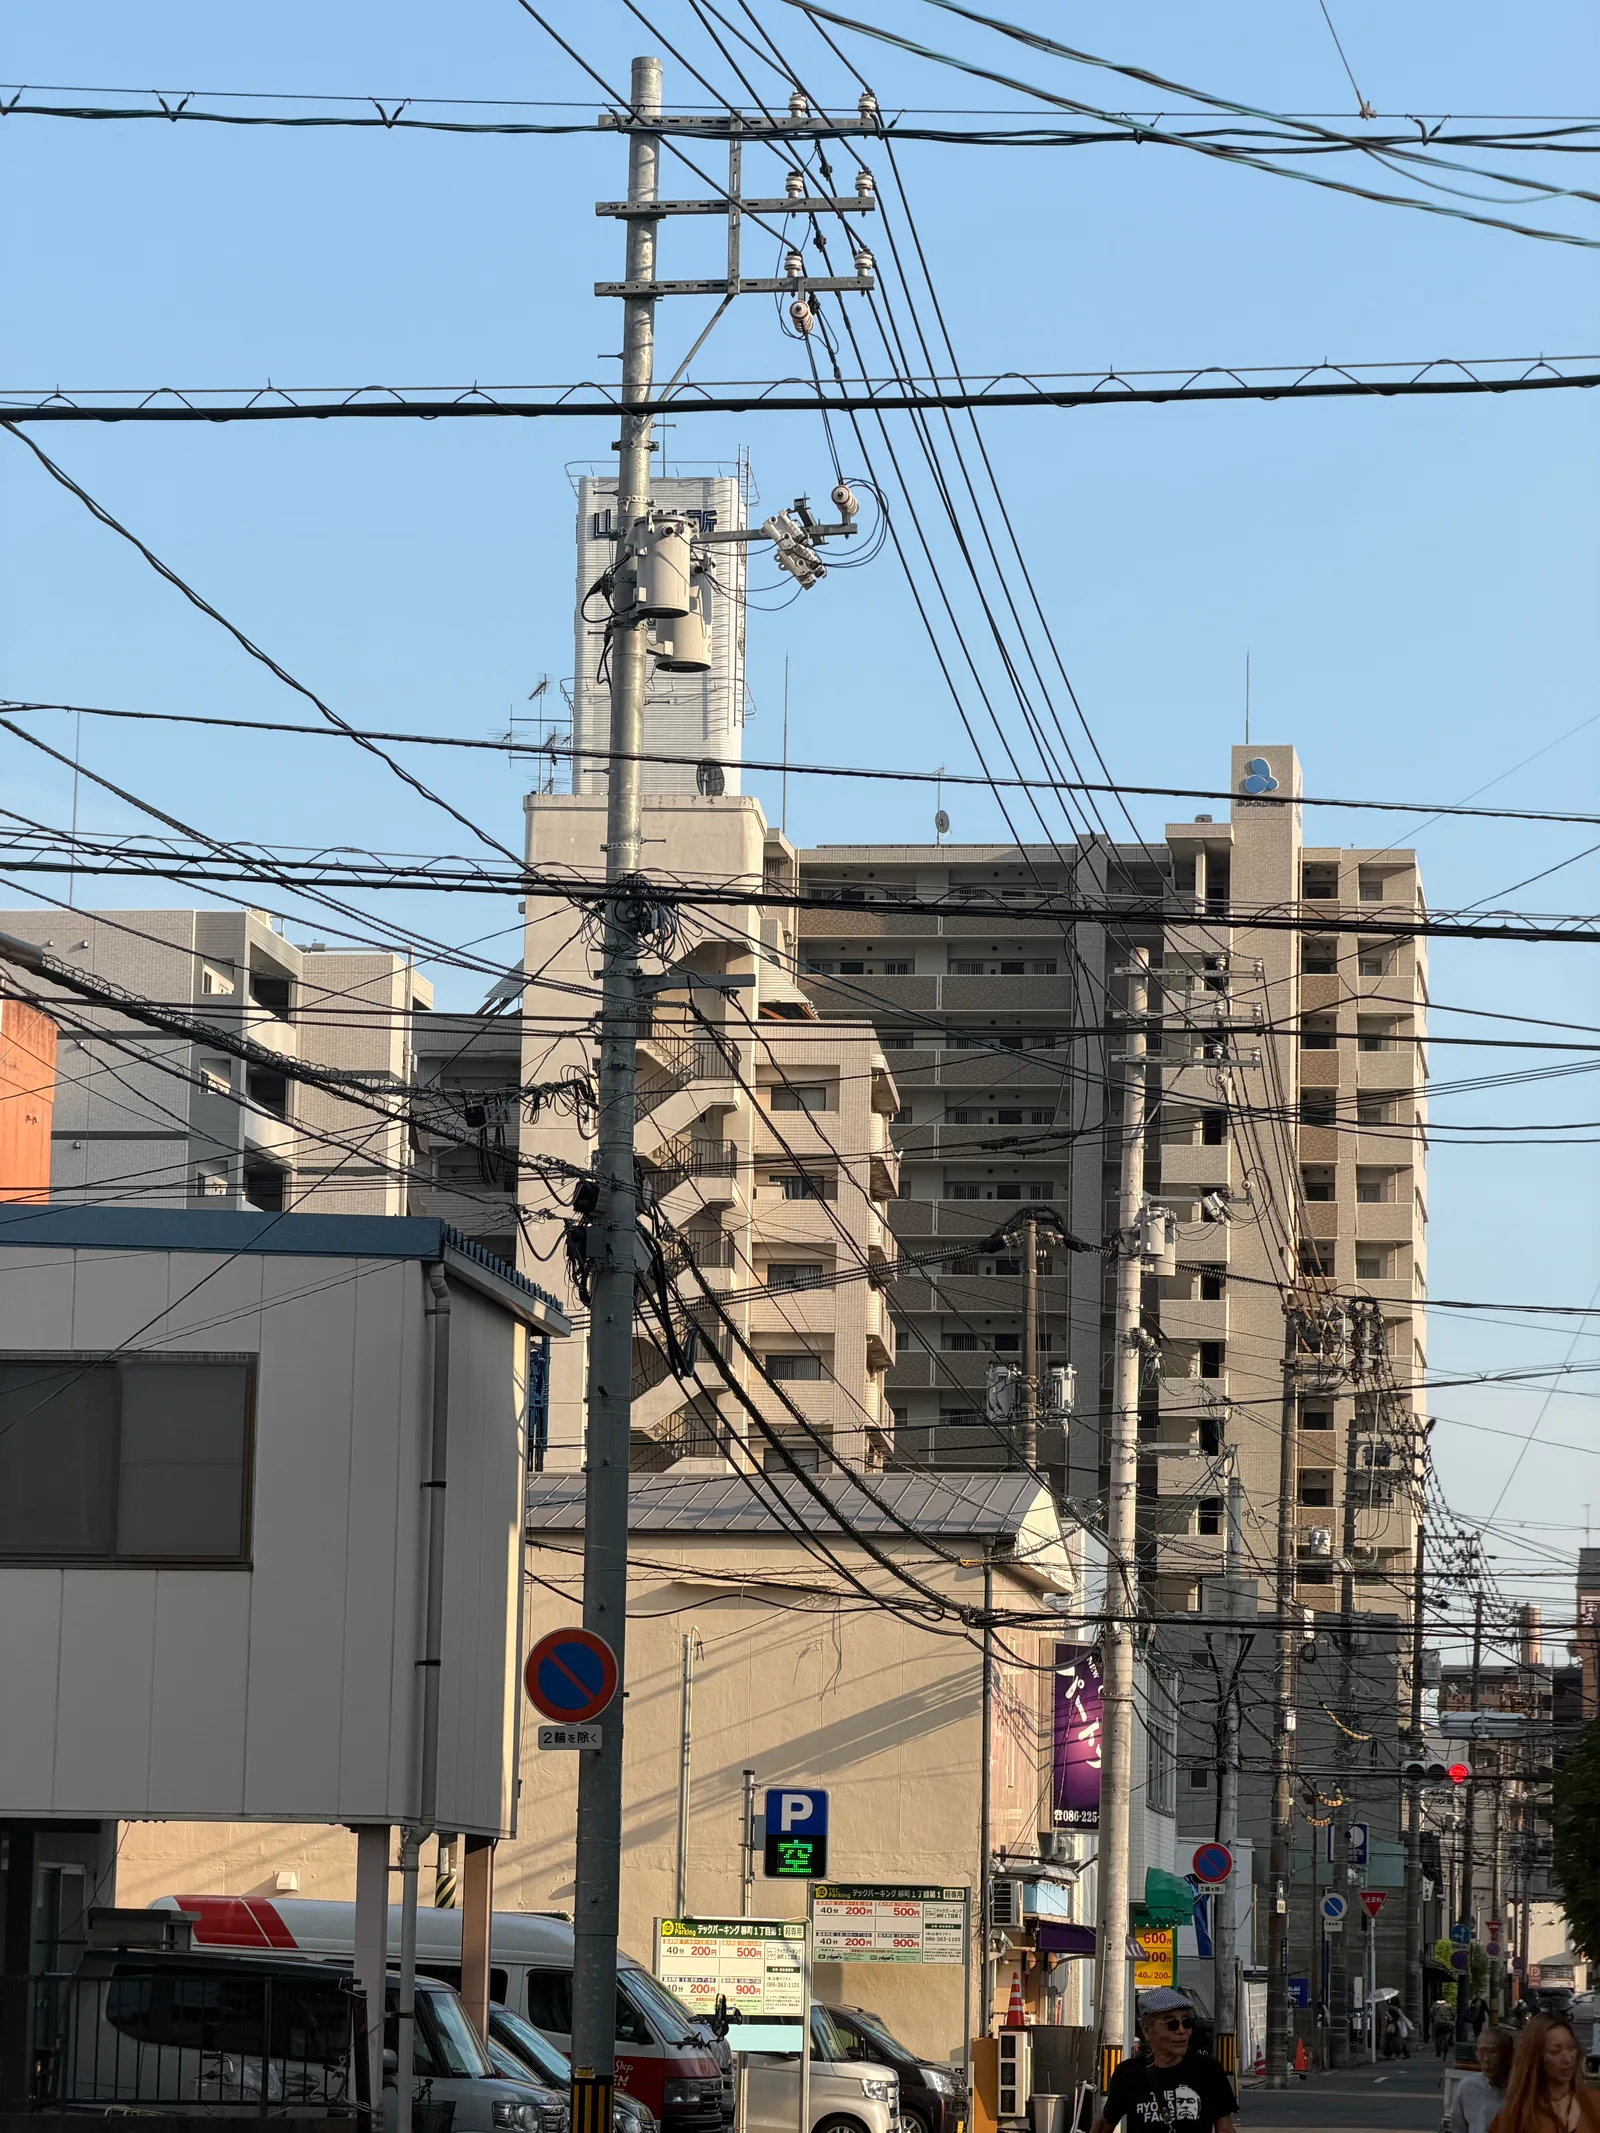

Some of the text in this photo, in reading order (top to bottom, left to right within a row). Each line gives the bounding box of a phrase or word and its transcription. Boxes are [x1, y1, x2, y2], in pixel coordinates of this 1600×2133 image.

[543, 1731, 597, 1744] 2輪を除く
[780, 1793, 814, 1832] P
[777, 1839, 813, 1874] 空
[820, 1906, 872, 1915] 40分 200円
[893, 1907, 920, 1916] 500円
[674, 1928, 697, 1937] Parking
[819, 1937, 872, 1947] 40分 200円
[892, 1938, 920, 1948] 900円
[1144, 1933, 1172, 1944] 600円
[666, 1945, 717, 1956] 40分 200円
[736, 1947, 762, 1958] 500円
[690, 1983, 716, 1994] 200円
[736, 1984, 761, 1995] 900円
[614, 2060, 633, 2073] Shop
[1136, 2101, 1175, 2114] RYOA
